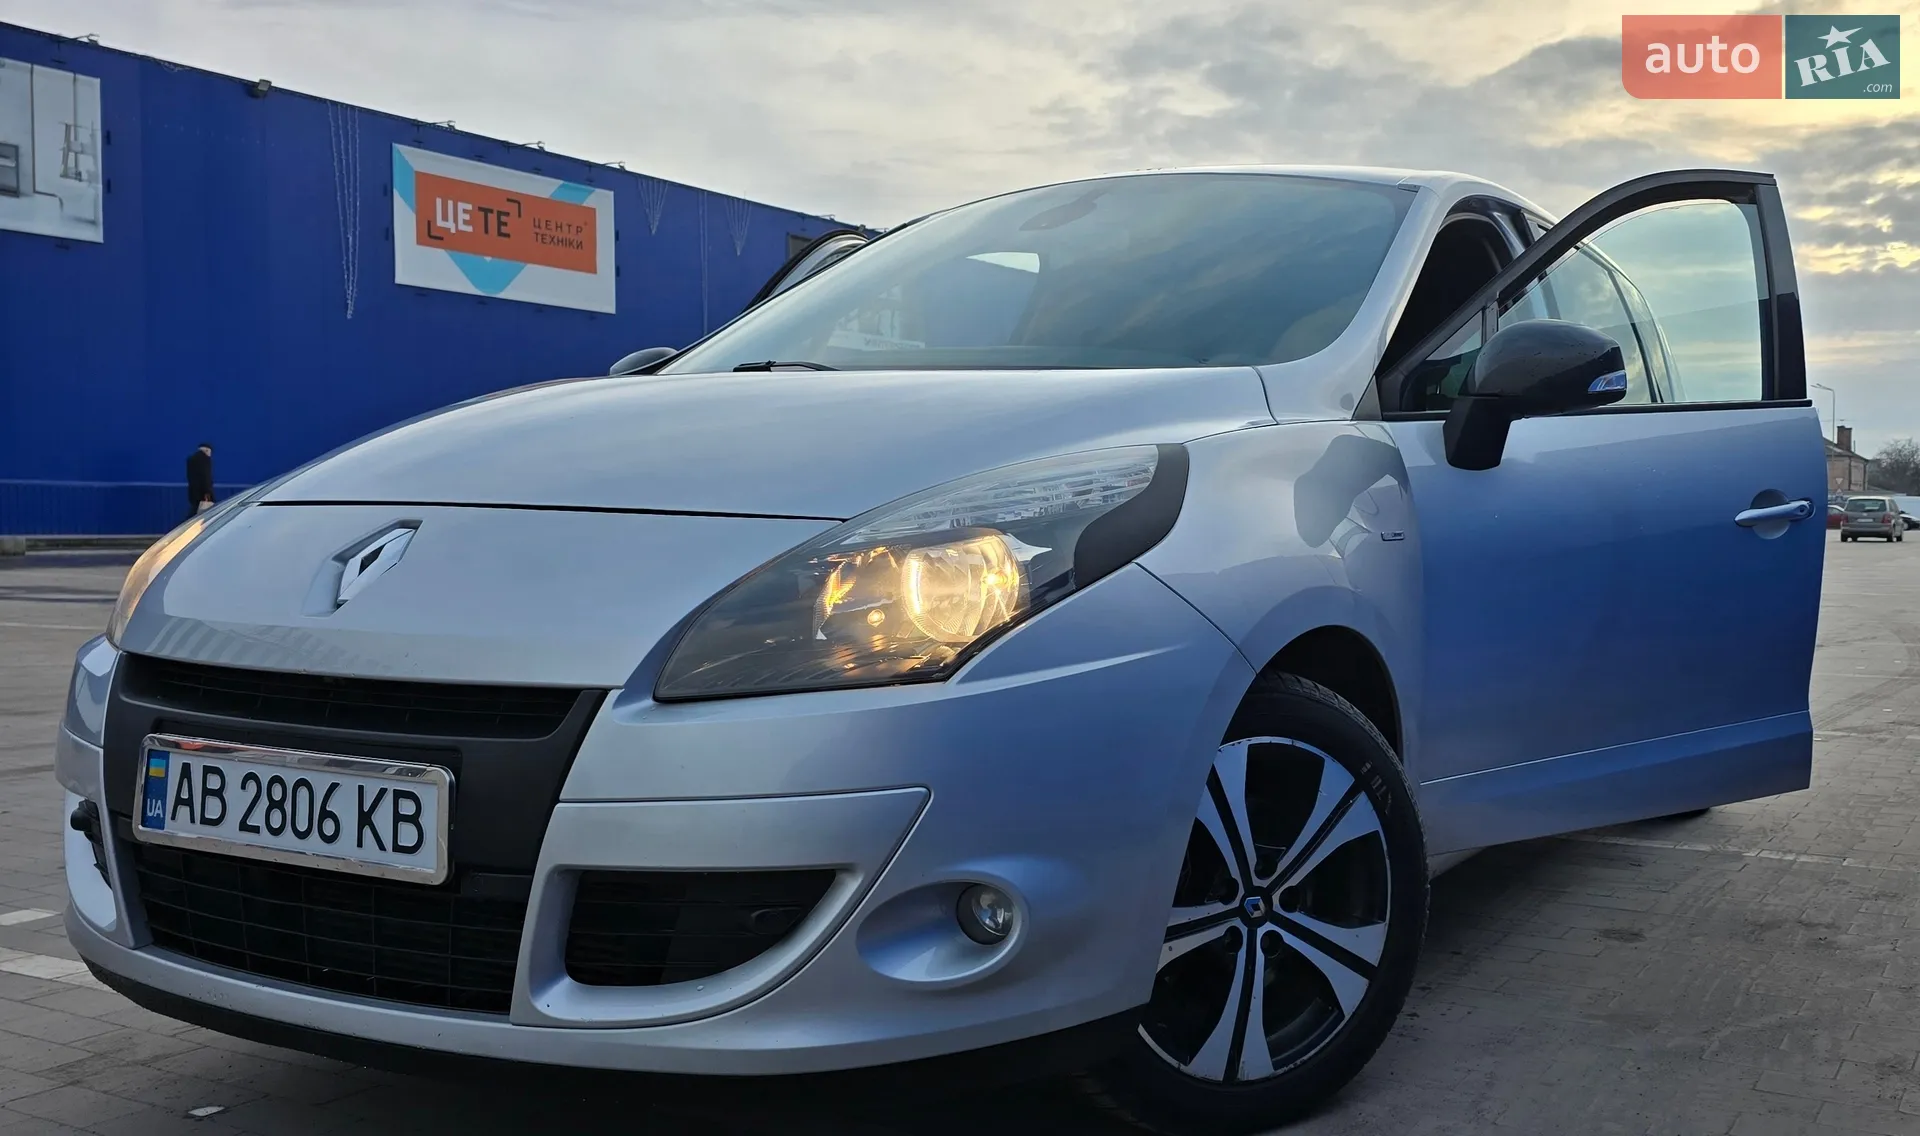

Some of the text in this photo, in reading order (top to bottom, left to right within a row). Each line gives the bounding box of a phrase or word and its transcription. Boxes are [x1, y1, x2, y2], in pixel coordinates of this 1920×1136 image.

[532, 217, 584, 234] ЦЕНТР
[533, 232, 584, 250] ТЕХНІКИ
[146, 798, 164, 818] UA
[170, 762, 425, 855] AB 2806 KB
